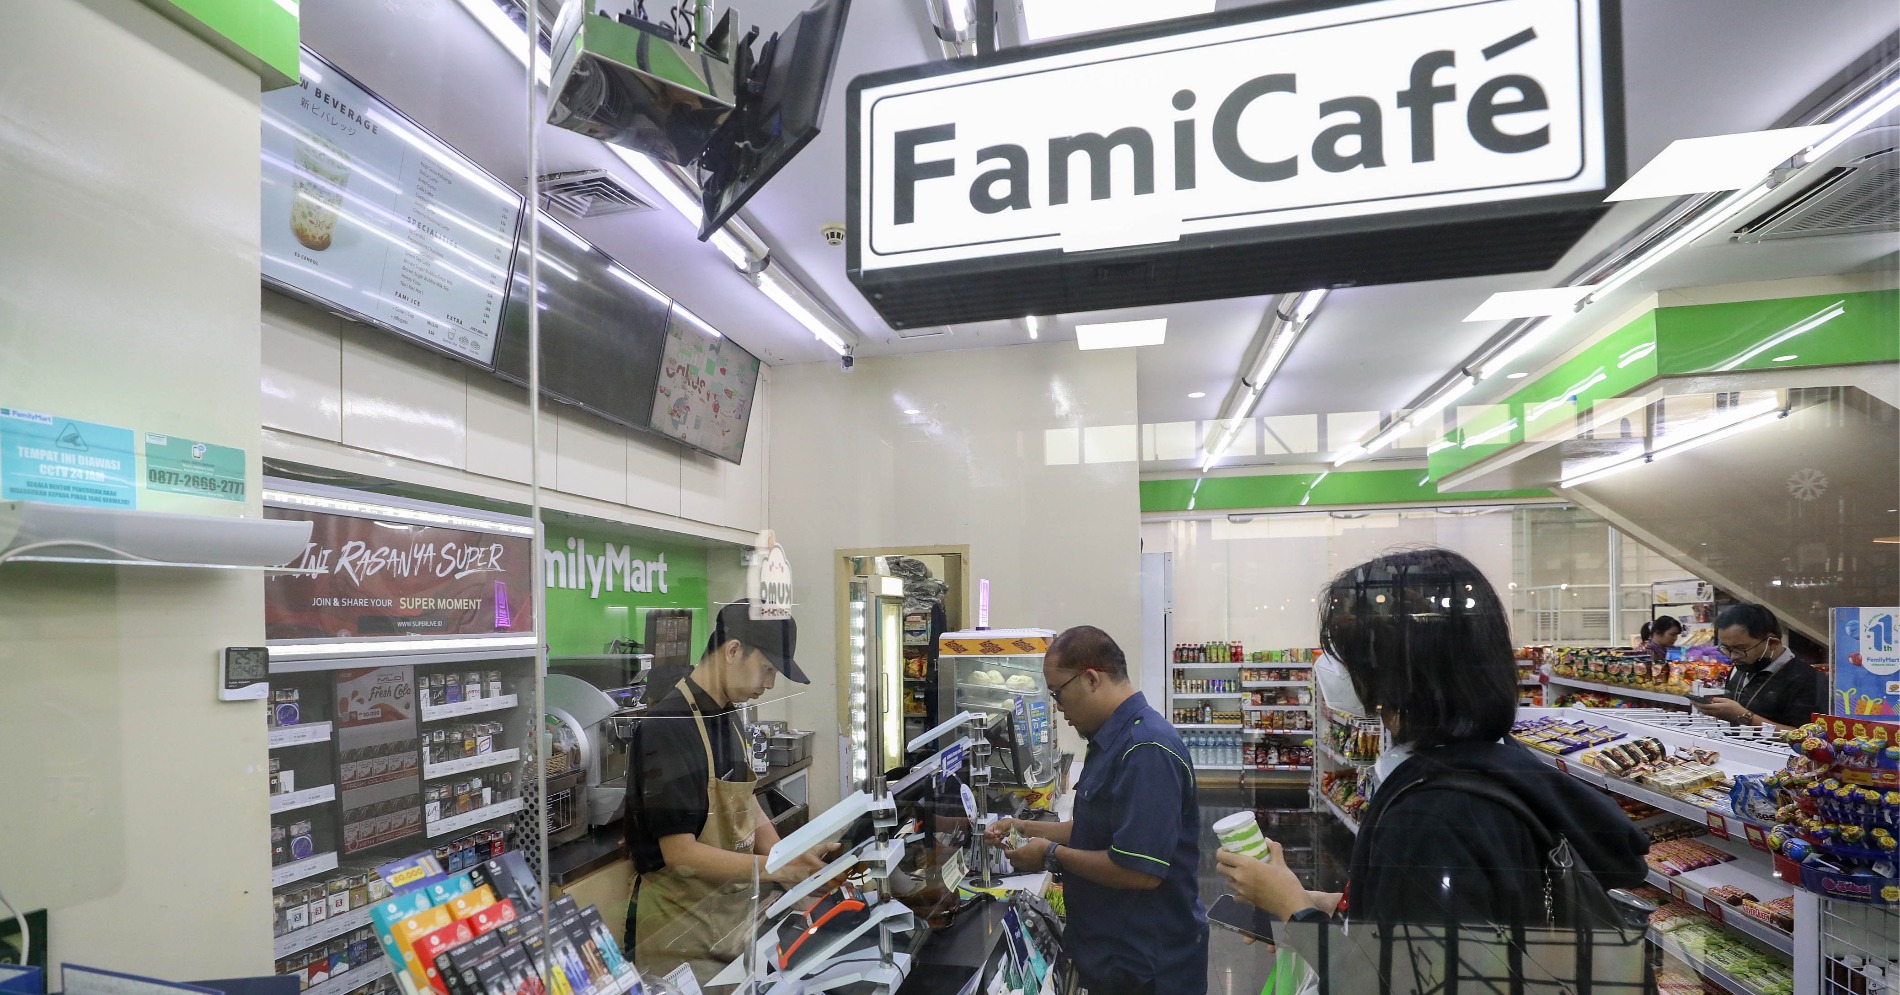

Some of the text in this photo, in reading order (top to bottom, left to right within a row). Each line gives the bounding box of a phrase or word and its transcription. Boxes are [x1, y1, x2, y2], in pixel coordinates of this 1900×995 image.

[315, 87, 379, 135] BEVERAGE
[893, 26, 1551, 226] FamiCafé
[12, 410, 51, 422] FamilyMart
[17, 446, 121, 471] TEMPAT INI DIAWASI
[39, 464, 105, 483] CCTV 24 JAM
[300, 540, 505, 587] INI RASANYA SUPER
[544, 536, 668, 599] milyMart
[312, 597, 482, 611] JOIN & SHARE YOUR SUPER MOMENT
[1866, 656, 1900, 664] FamilyMart
[368, 686, 391, 702] Fresh
